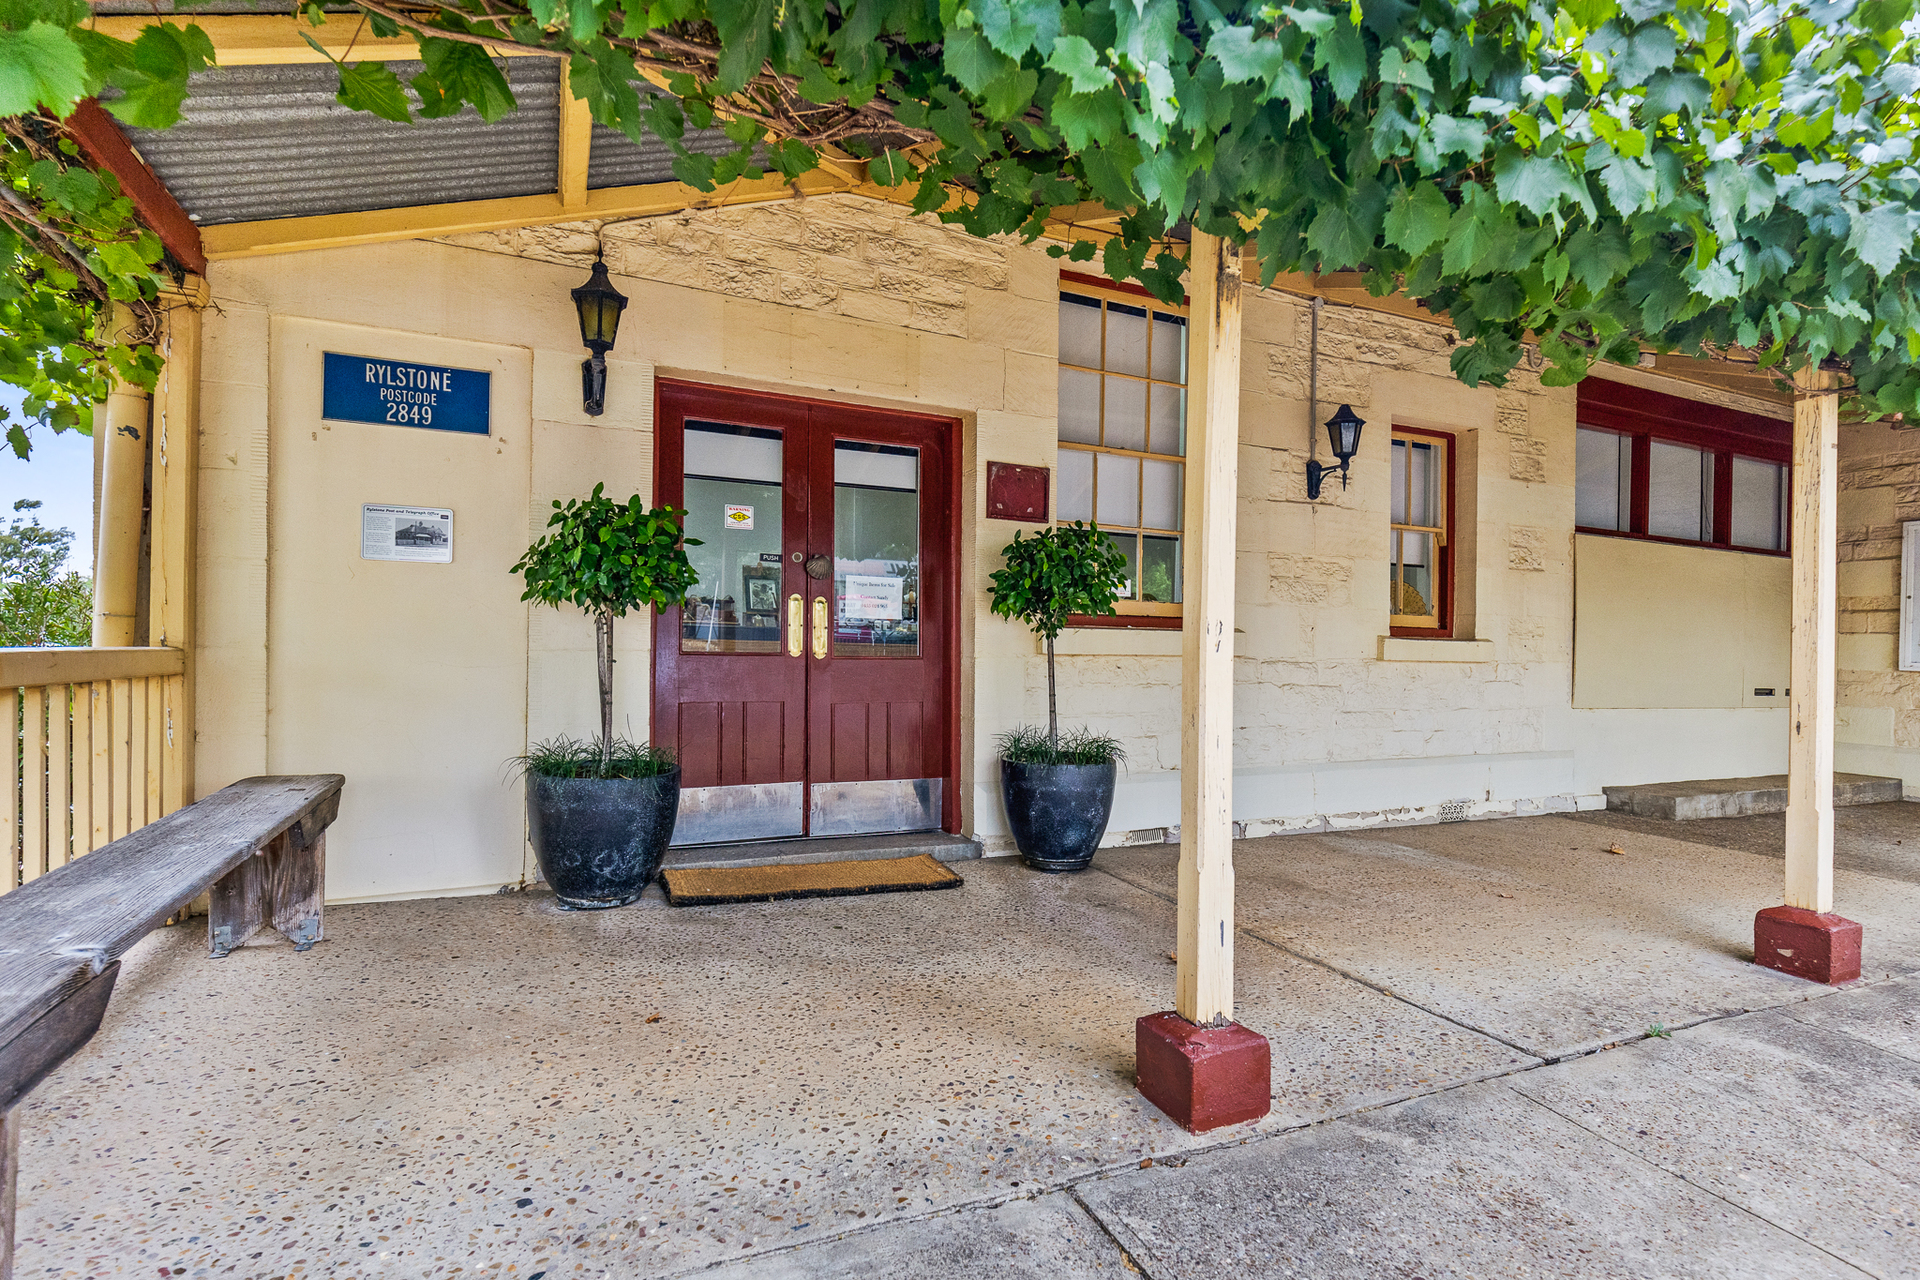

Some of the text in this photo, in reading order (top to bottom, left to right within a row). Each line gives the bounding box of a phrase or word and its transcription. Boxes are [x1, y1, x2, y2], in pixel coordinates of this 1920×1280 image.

[365, 363, 452, 392] RYLSTONE
[380, 387, 437, 406] POSTCODE
[386, 402, 432, 425] 2849
